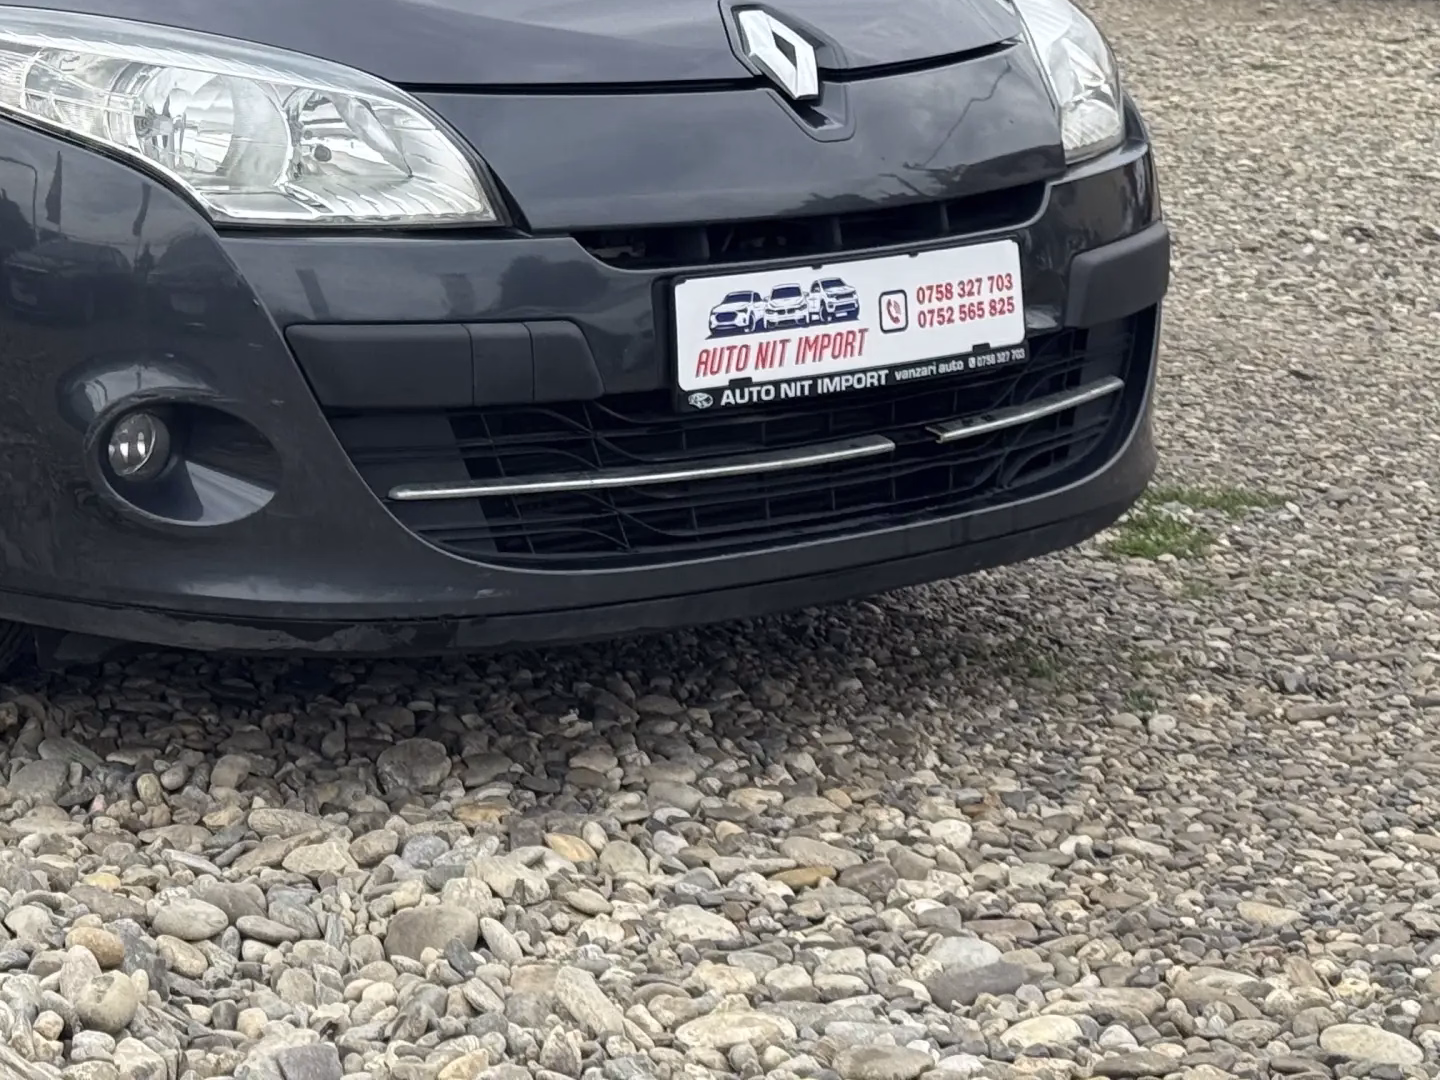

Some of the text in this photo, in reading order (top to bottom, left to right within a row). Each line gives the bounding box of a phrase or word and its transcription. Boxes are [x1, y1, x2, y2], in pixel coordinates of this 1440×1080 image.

[916, 272, 1013, 305] 0758 327 703
[917, 296, 1015, 329] 0752 565 825
[695, 328, 870, 379] AUTO NIT IMPORT
[720, 384, 776, 406] AUTO
[780, 379, 815, 399] NIT
[817, 370, 889, 394] IMPORT
[894, 361, 936, 380] vanzari
[938, 360, 964, 374] auto
